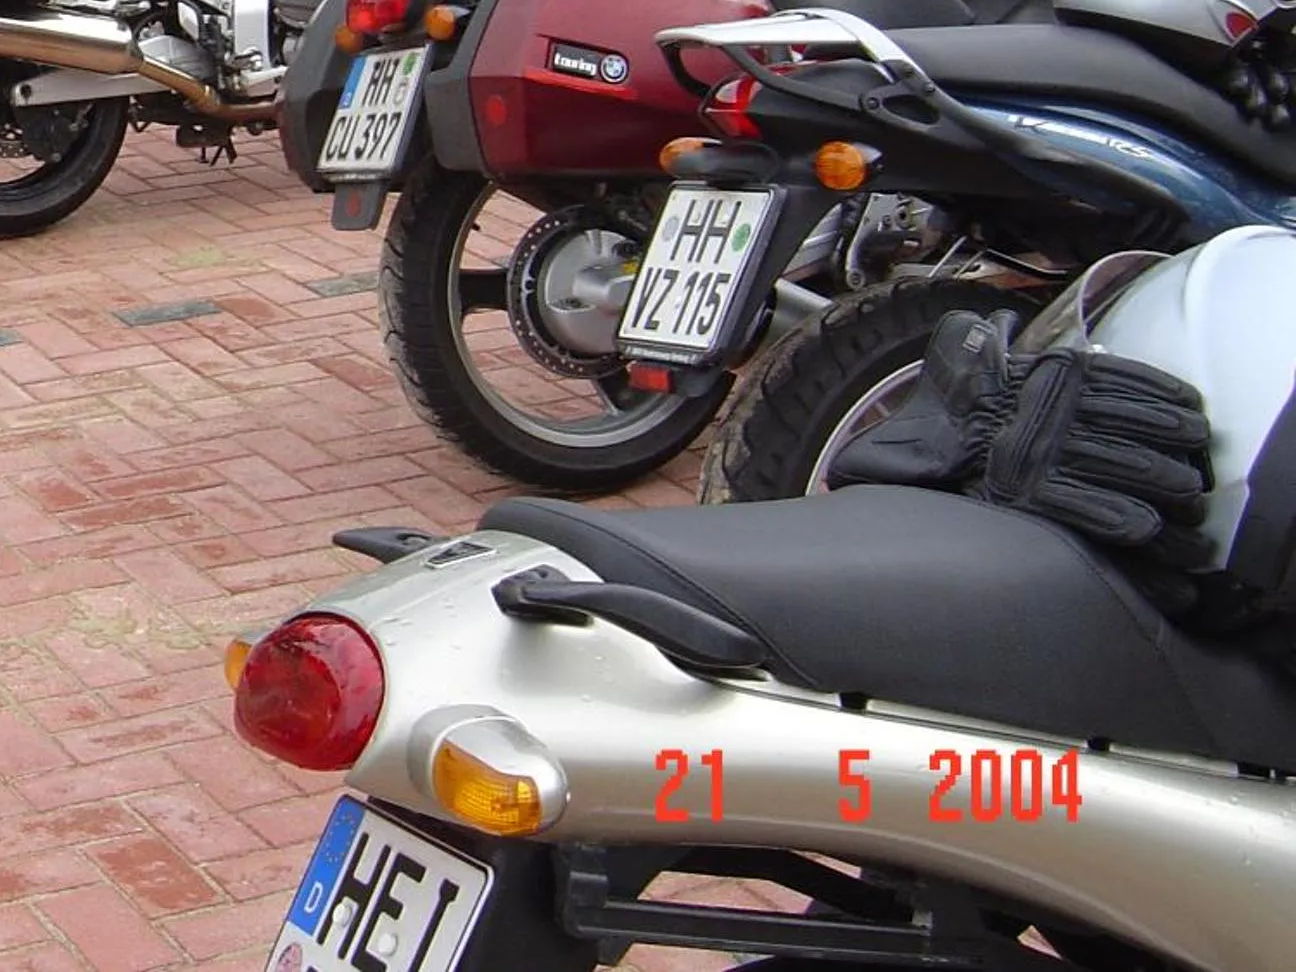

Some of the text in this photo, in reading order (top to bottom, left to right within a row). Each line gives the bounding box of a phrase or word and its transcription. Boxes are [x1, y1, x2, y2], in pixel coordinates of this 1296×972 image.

[325, 111, 402, 162] CU 397
[670, 199, 742, 264] HH
[632, 266, 731, 335] VZ 115
[304, 881, 323, 914] D
